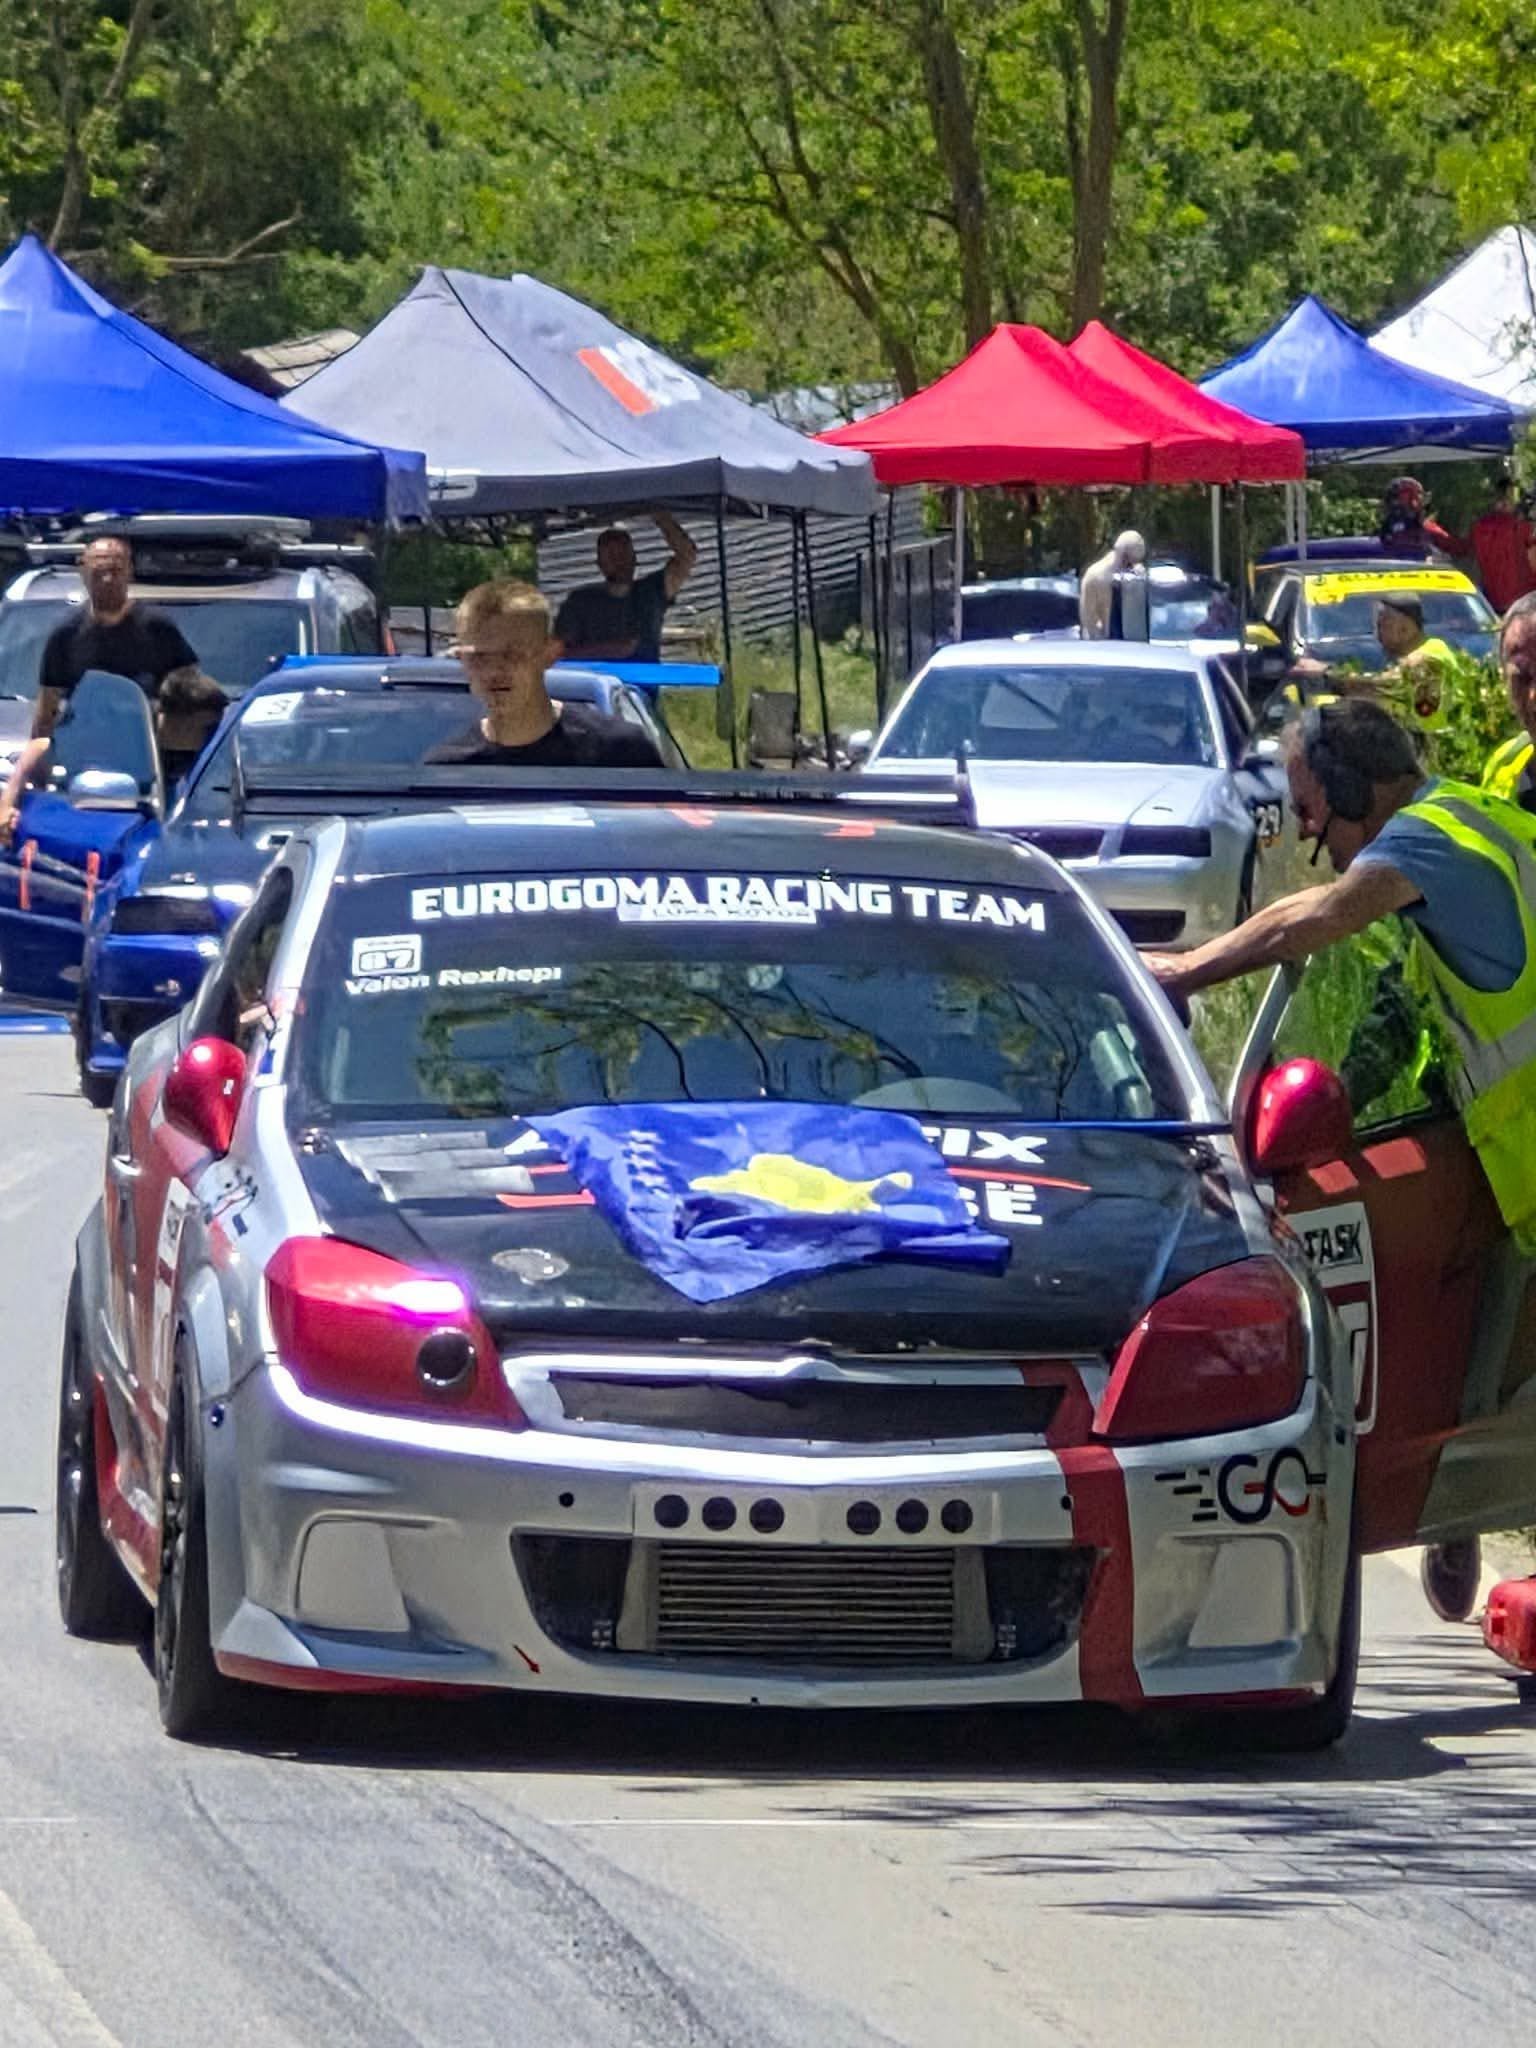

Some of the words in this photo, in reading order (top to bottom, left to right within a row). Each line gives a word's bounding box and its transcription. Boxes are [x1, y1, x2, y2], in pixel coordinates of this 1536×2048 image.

[411, 877, 698, 920] EUROGOMA
[706, 877, 892, 914] RACING
[901, 886, 1046, 932] TEAM
[345, 974, 430, 995] Valon
[438, 966, 562, 987] Rexhepi
